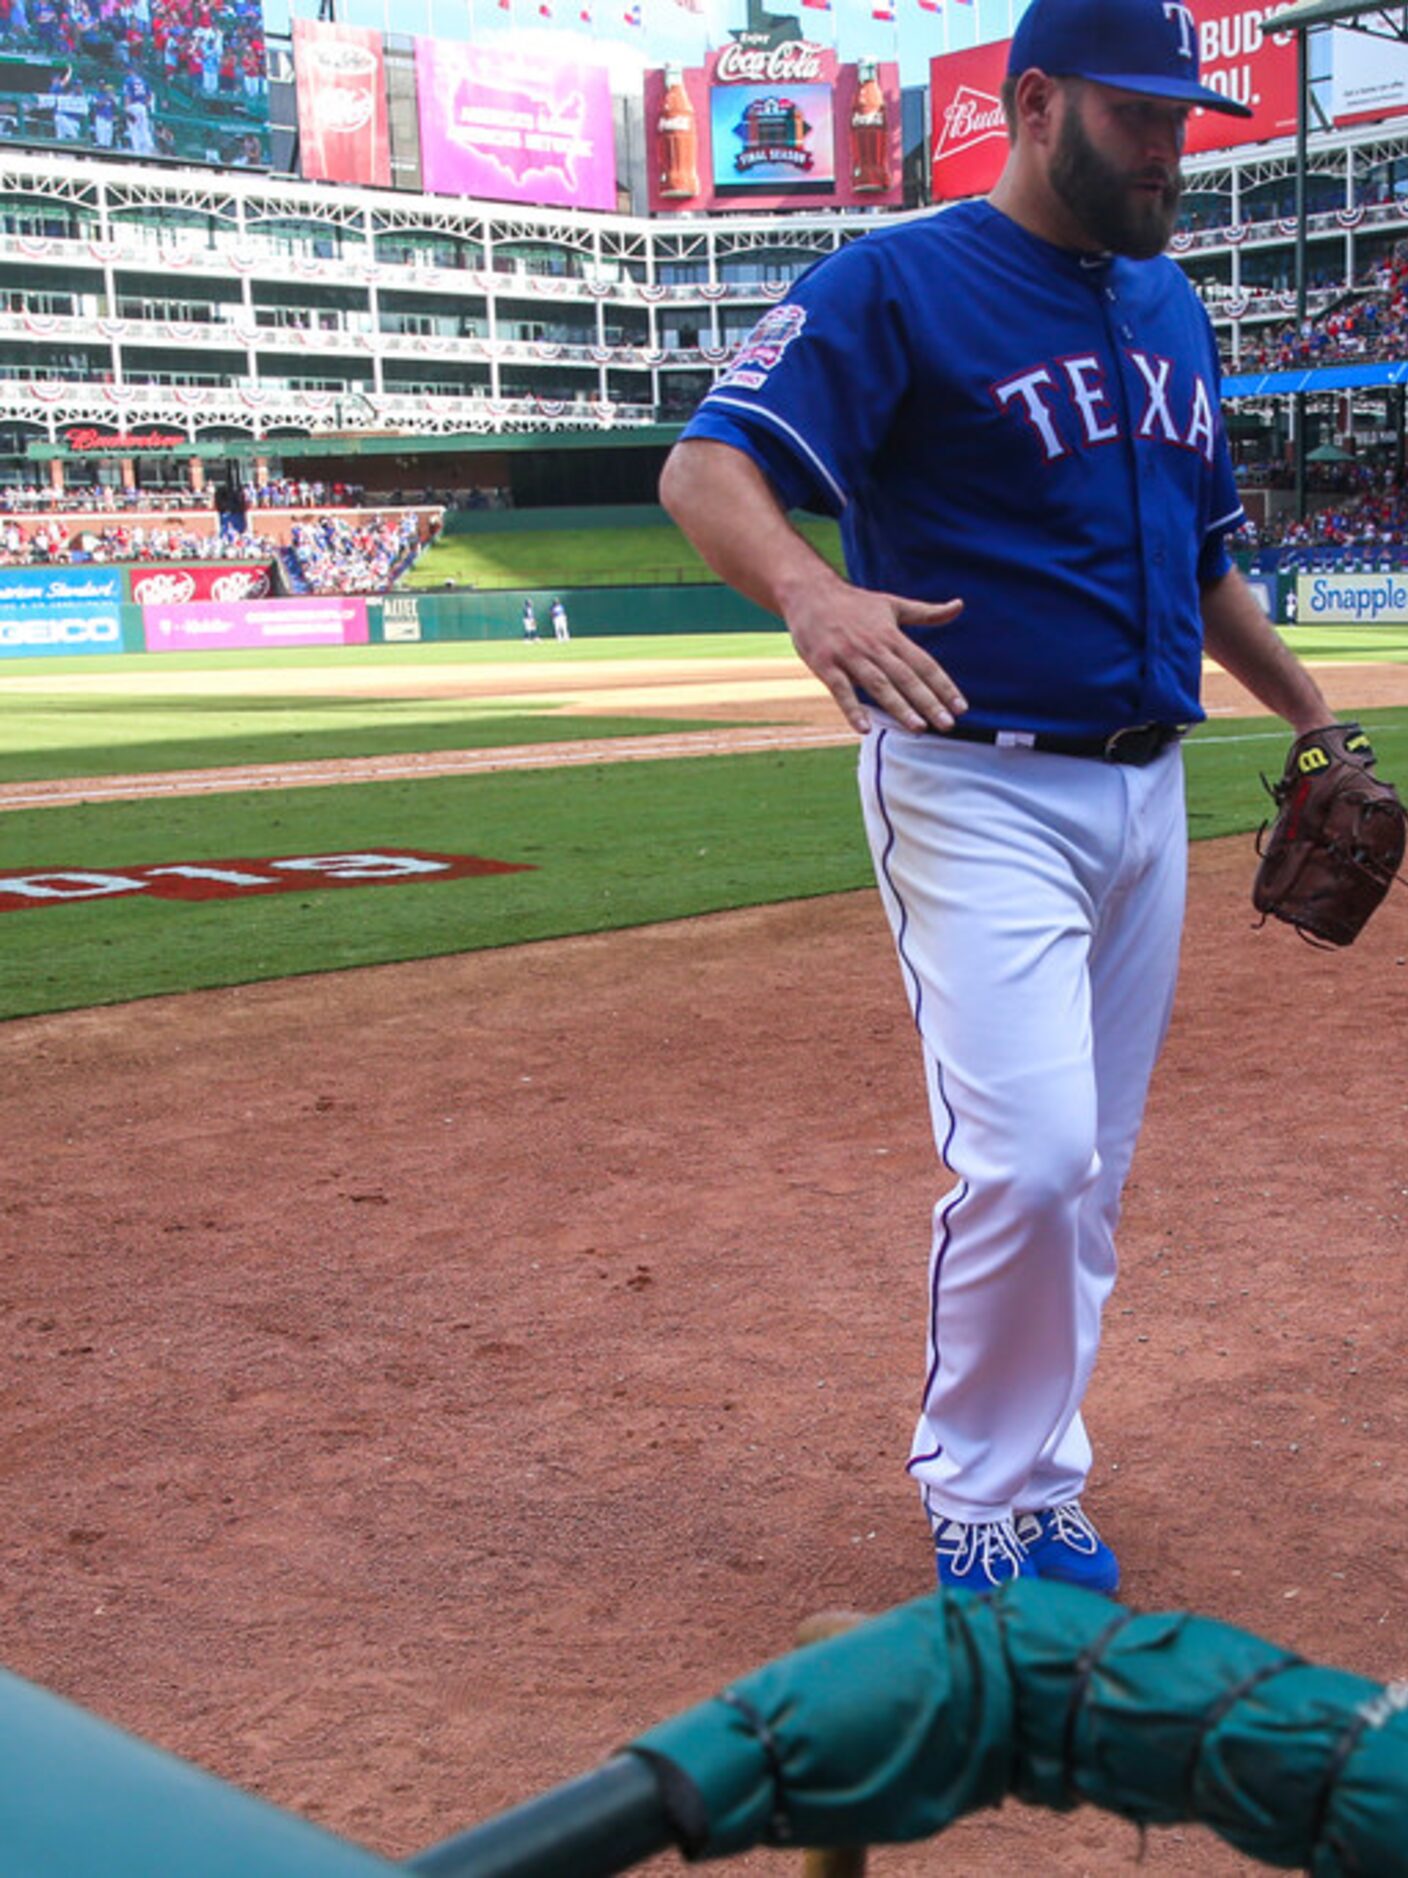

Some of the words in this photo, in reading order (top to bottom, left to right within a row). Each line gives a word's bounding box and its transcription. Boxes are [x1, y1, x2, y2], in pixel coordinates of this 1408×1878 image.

[1163, 2, 1193, 59] T
[717, 41, 822, 81] Coca-Cola
[1310, 578, 1406, 618] Snapple
[0, 617, 118, 645] GEICO
